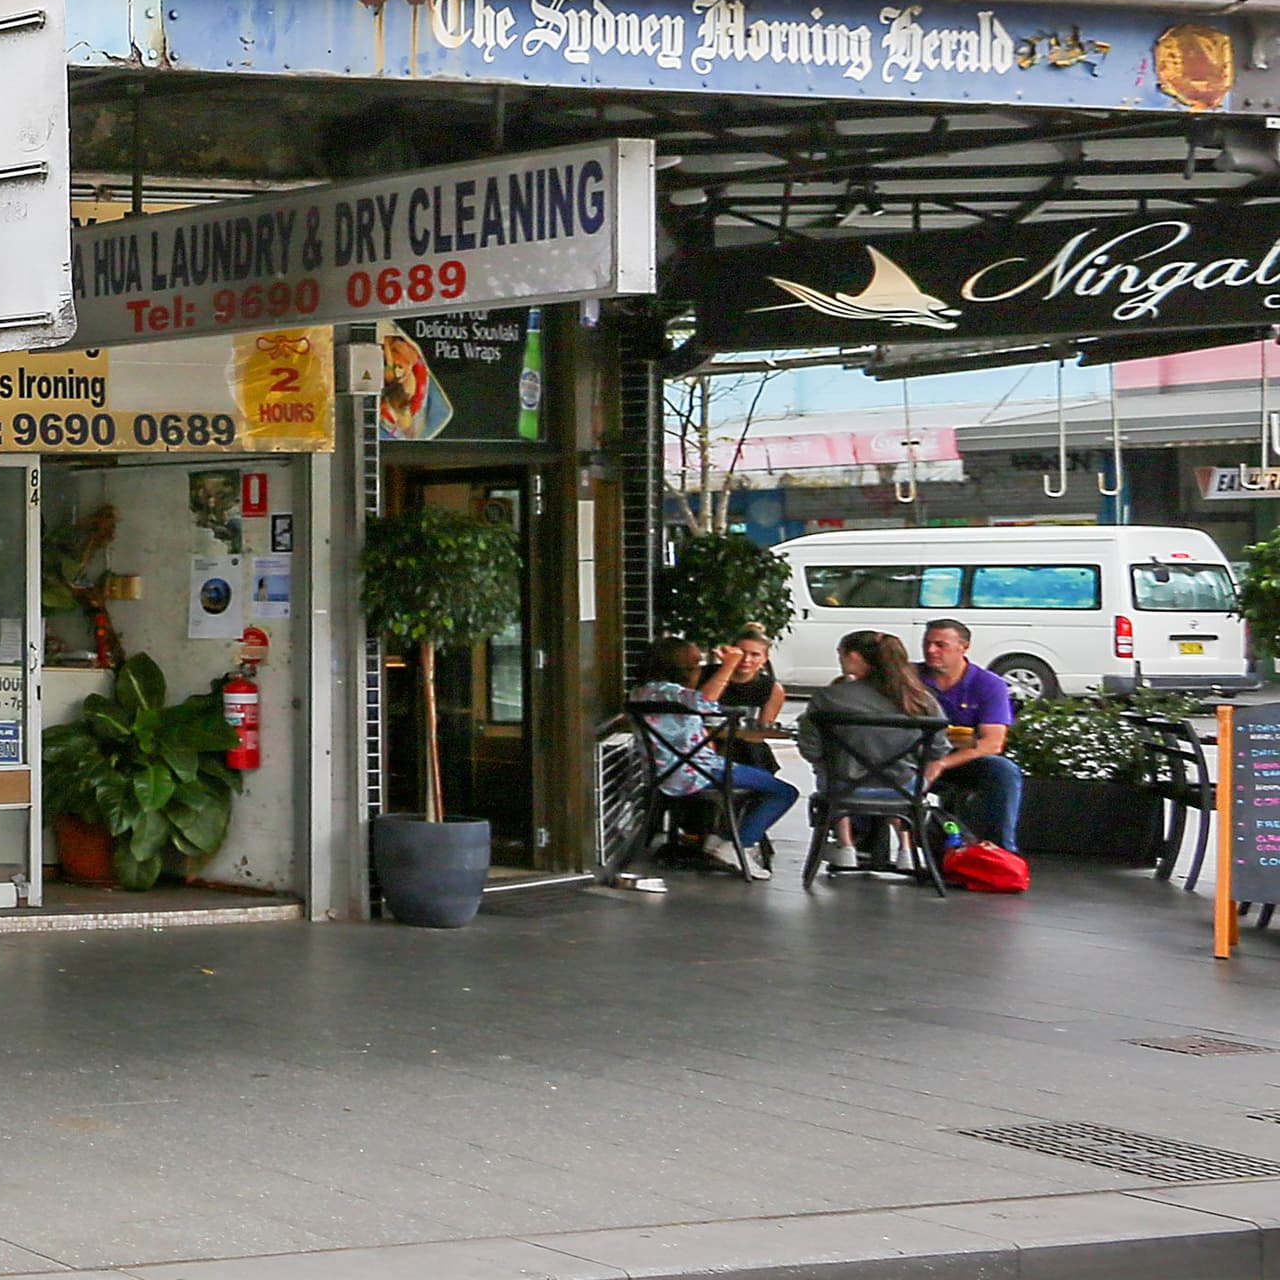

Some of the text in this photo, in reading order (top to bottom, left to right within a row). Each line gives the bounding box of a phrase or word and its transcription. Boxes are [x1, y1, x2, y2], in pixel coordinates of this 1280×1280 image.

[880, 5, 1015, 84] Herald
[94, 234, 143, 298] HUA
[151, 208, 296, 292] LAUNDRY
[302, 206, 323, 271] &
[334, 192, 399, 268] DRY
[408, 159, 606, 257] CLEANING
[126, 260, 468, 334] Tel: 9690 0689
[415, 319, 520, 342] Delicious Souvlaki
[435, 340, 502, 365] Pita Wraps
[18, 367, 107, 408] Ironing
[269, 367, 302, 393] 2
[12, 413, 116, 447] 9690
[133, 413, 237, 447] 0689
[259, 403, 315, 423] HOURS
